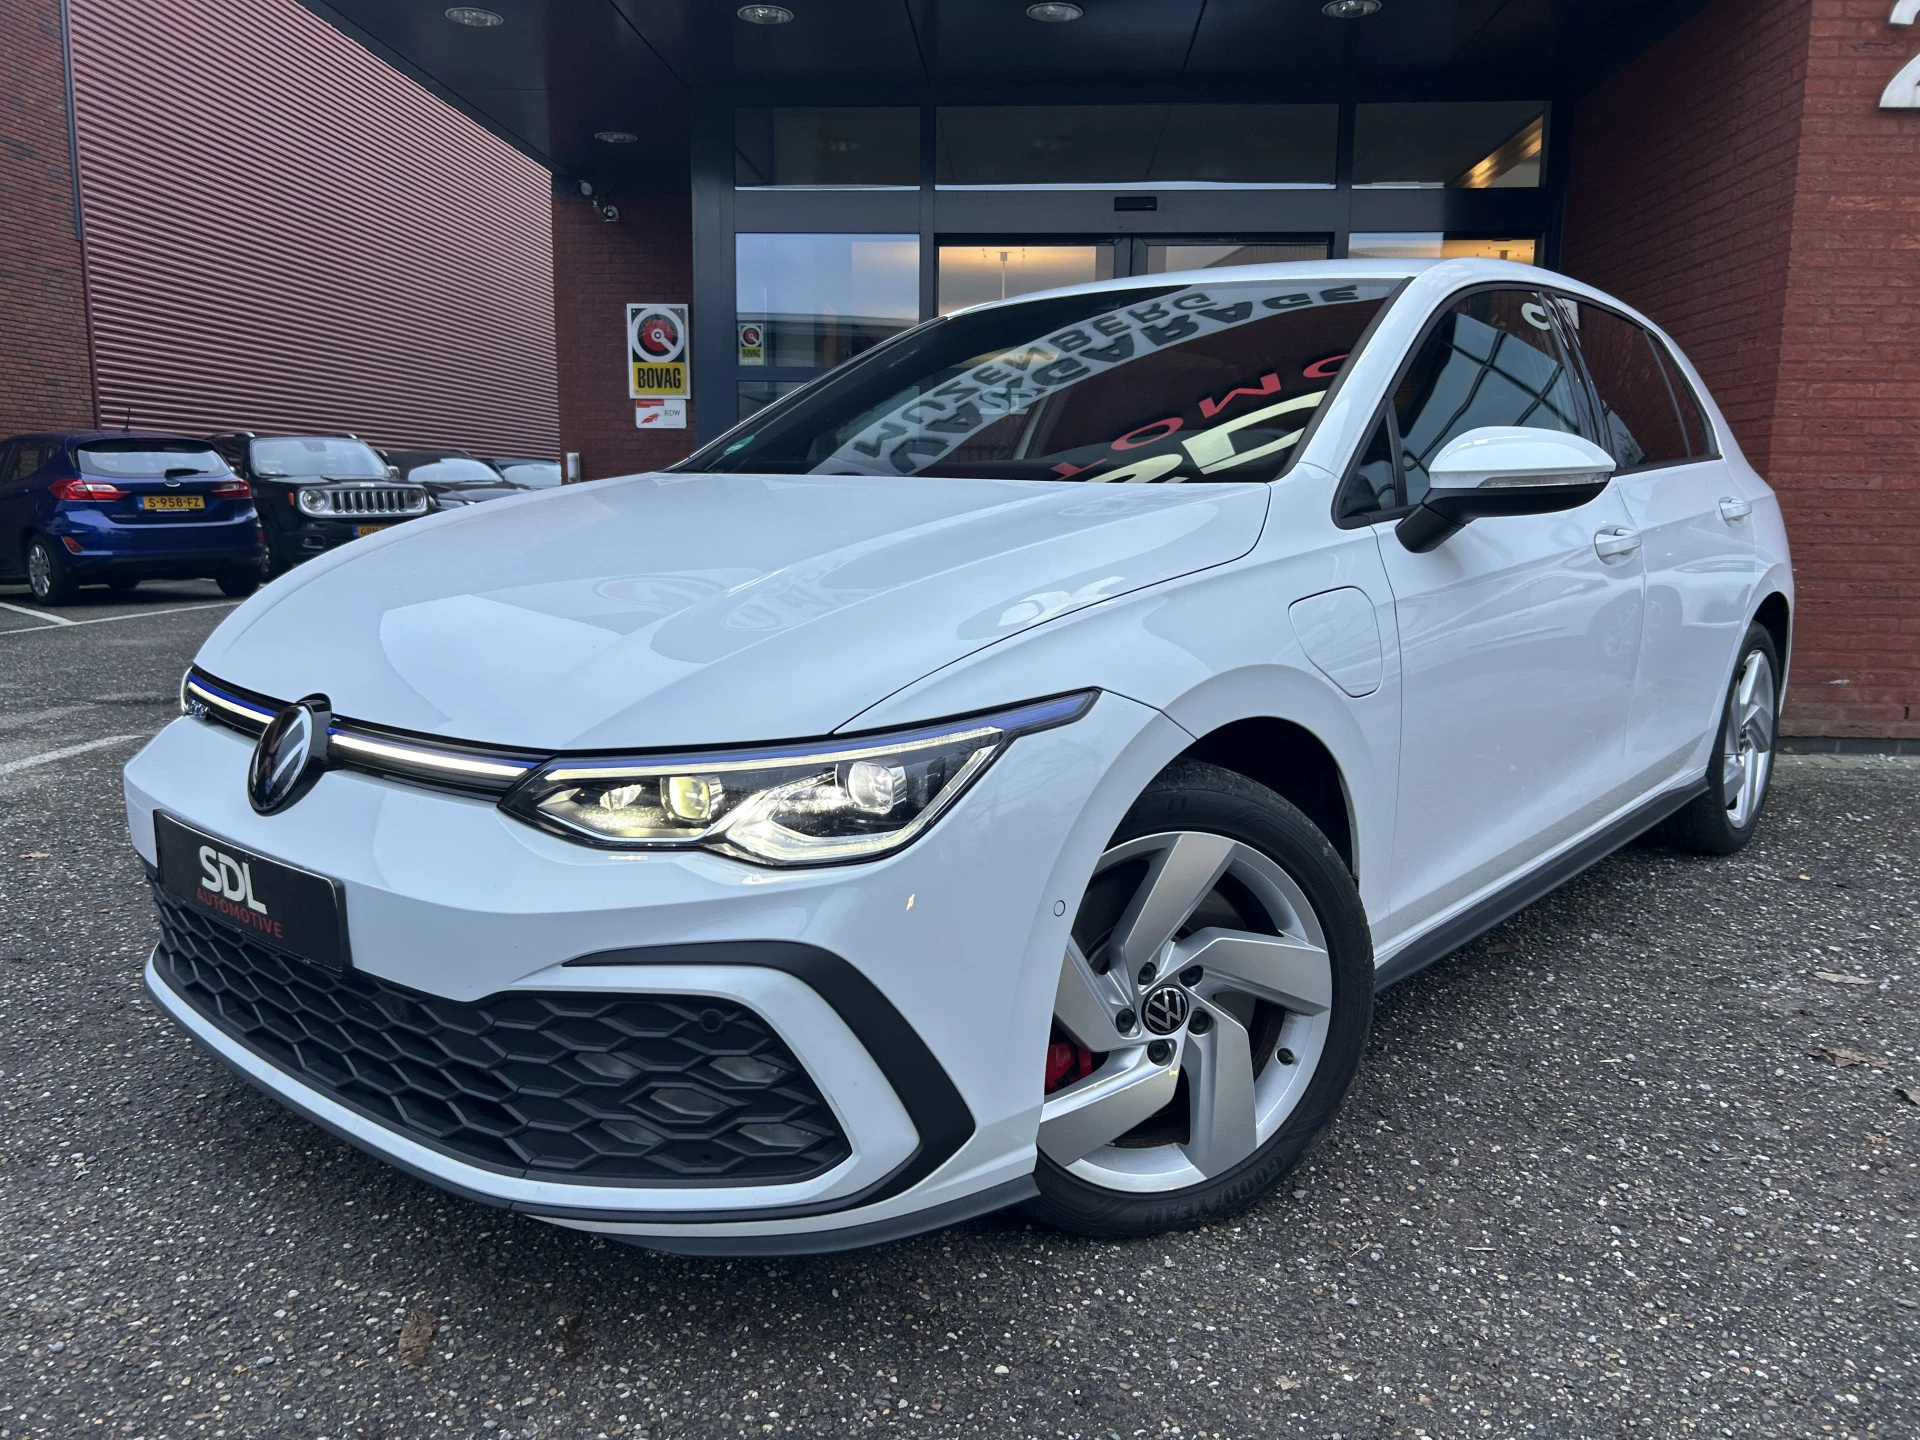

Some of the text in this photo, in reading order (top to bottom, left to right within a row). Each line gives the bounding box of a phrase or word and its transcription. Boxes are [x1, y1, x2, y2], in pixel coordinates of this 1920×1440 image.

[742, 348, 761, 359] BOVAG
[637, 367, 681, 389] BOVAG
[664, 409, 681, 417] RDW
[149, 497, 200, 508] S-958-FZ
[199, 845, 268, 915] SDL
[196, 887, 284, 939] AUTOMOTIVE
